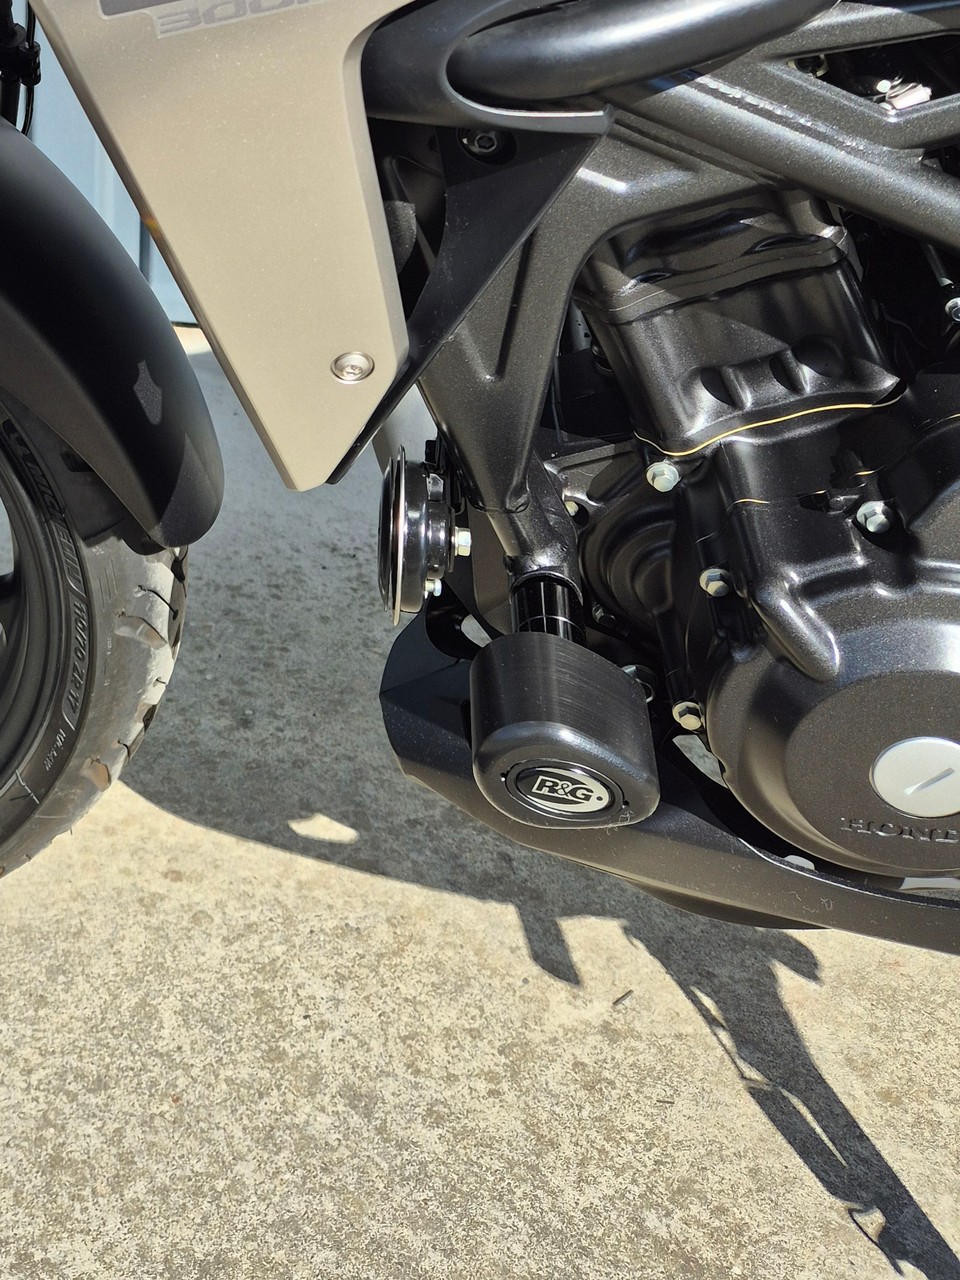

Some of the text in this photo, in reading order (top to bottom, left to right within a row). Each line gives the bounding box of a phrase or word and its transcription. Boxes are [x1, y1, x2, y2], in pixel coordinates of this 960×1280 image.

[73, 600, 89, 662] 110/70
[71, 661, 86, 691] ZR
[534, 777, 595, 802] R&G
